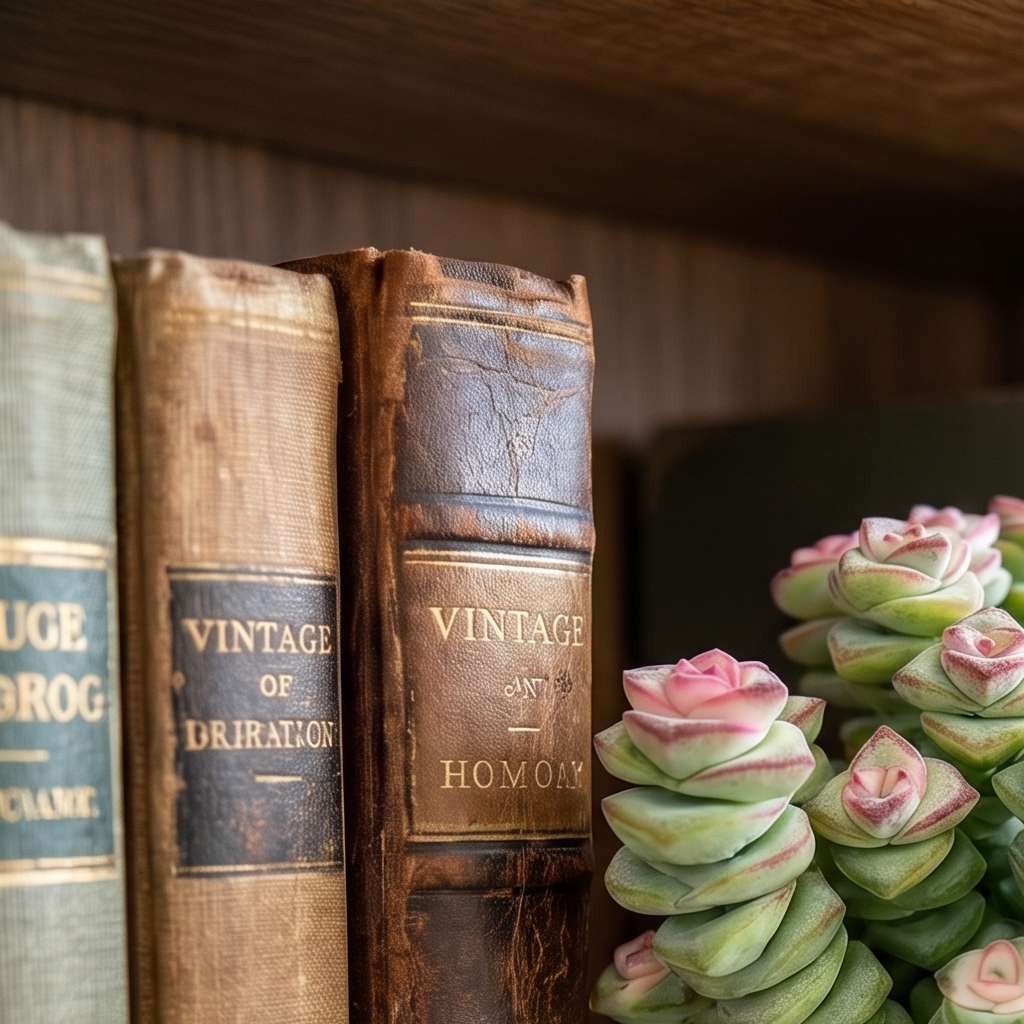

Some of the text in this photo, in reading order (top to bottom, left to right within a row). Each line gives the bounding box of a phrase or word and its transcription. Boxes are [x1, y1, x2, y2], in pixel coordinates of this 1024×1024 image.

[181, 618, 332, 654] VINTAGE
[430, 606, 584, 646] VINTAGE
[260, 674, 293, 697] OF
